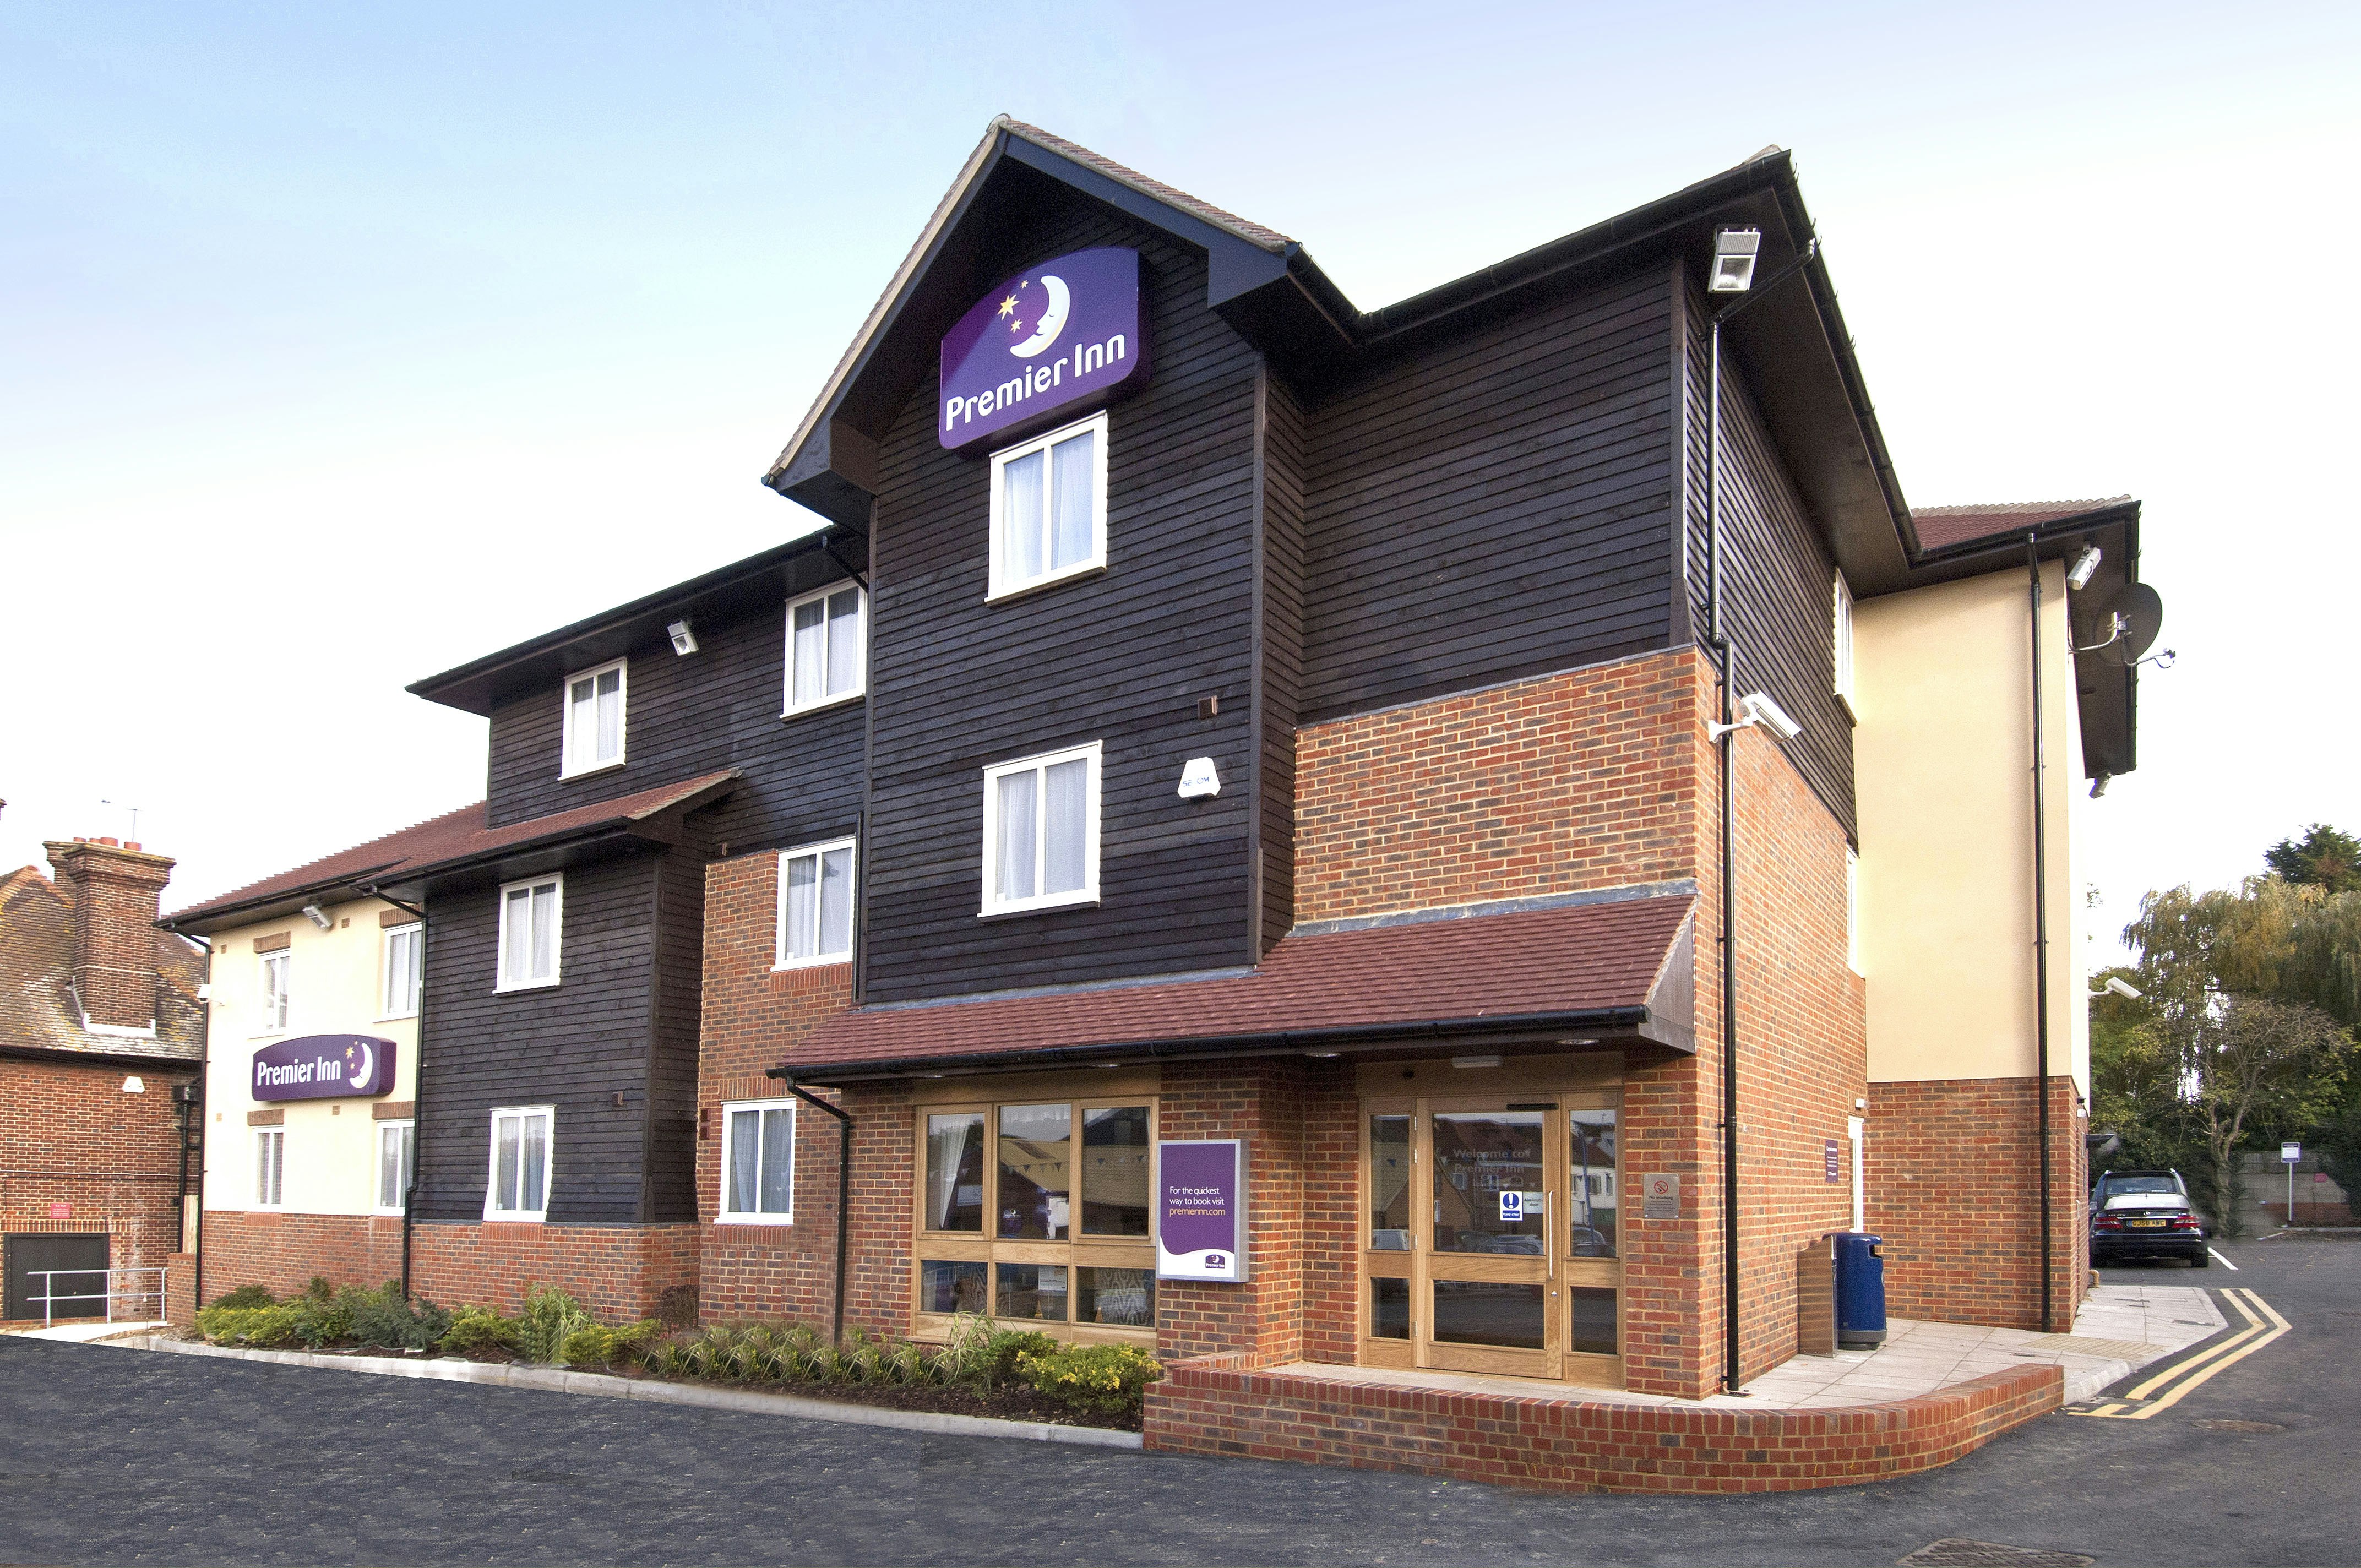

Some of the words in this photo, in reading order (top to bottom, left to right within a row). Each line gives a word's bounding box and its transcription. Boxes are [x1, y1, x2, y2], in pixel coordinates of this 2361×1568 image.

[946, 358, 1068, 431] Premier
[1075, 334, 1125, 378] Inn
[257, 1058, 315, 1086] Premier
[317, 1056, 341, 1081] Inn
[1169, 1186, 1181, 1194] For
[1194, 1186, 1220, 1196] quickest
[1193, 1197, 1211, 1205] book
[1212, 1197, 1225, 1205] visit
[1169, 1206, 1226, 1217] premierinn.com
